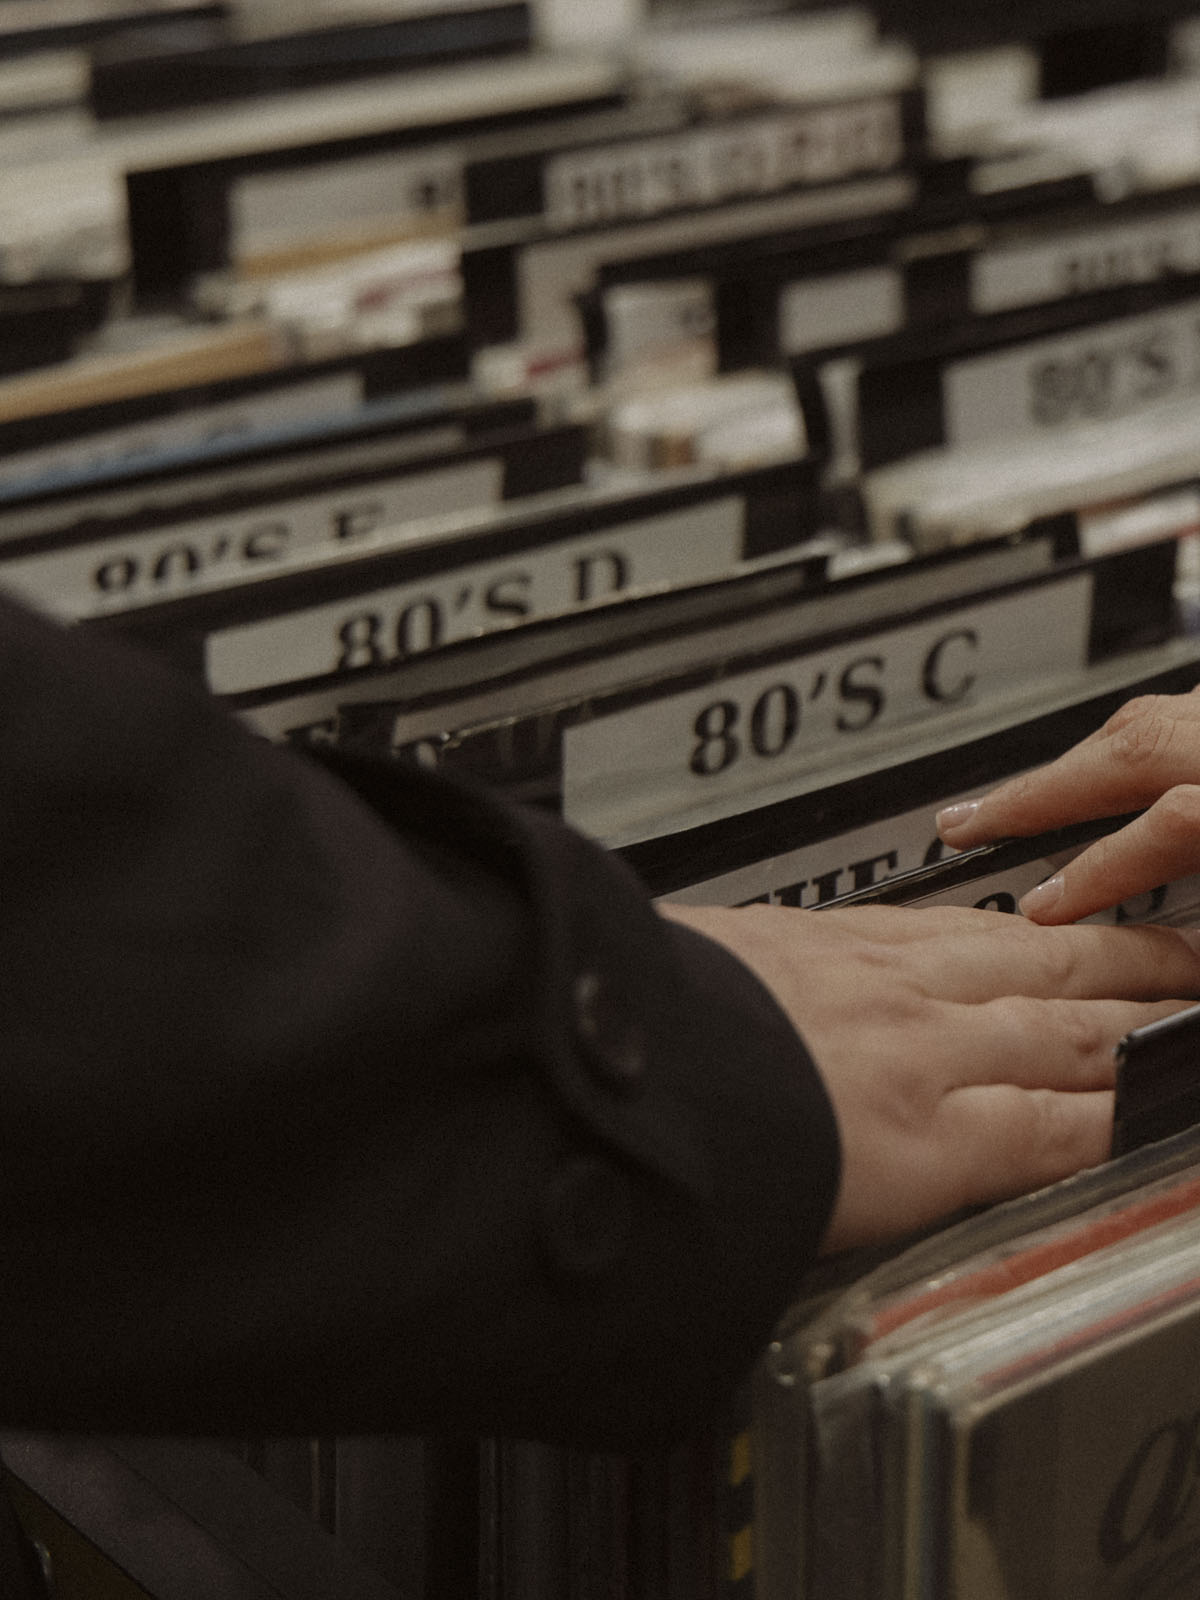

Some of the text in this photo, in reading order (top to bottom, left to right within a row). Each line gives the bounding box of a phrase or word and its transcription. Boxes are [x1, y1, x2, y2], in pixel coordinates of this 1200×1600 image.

[336, 545, 635, 671] 80'S D
[688, 627, 980, 778] 80'S C
